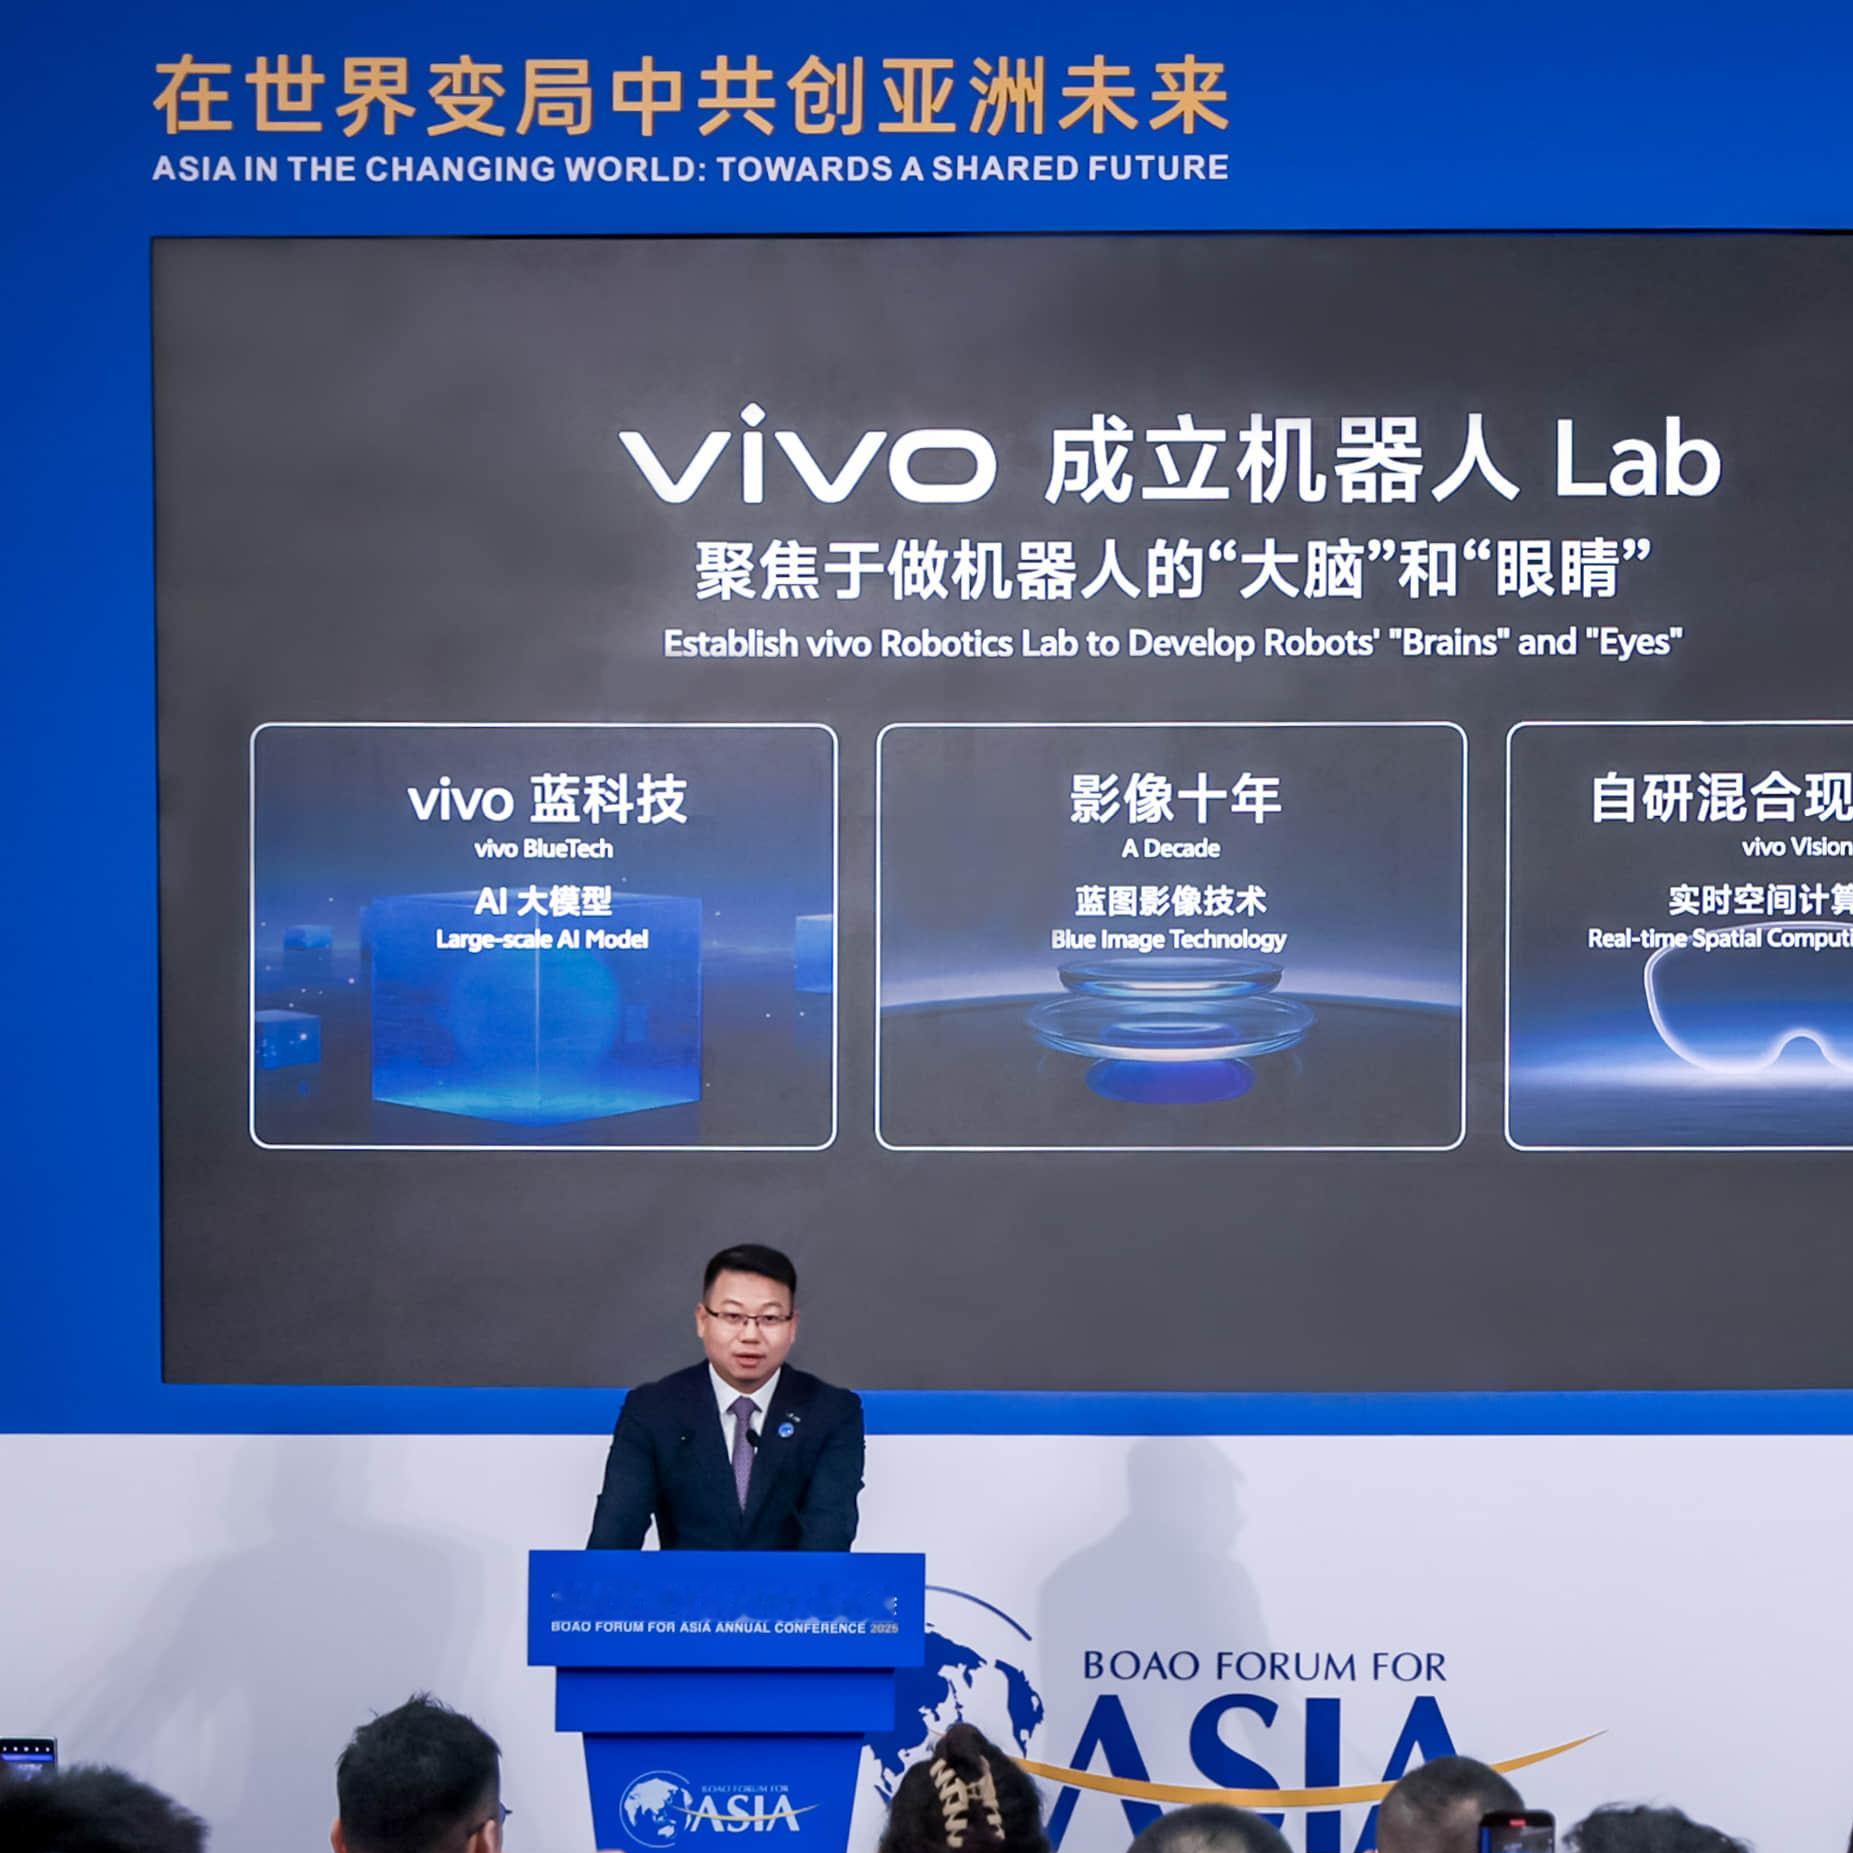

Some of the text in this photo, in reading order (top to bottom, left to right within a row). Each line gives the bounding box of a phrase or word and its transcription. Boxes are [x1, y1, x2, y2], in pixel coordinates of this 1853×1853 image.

[154, 54, 1228, 136] 在世界变局中共创亚洲未来
[153, 155, 1228, 181] ASIA IN THE CHANGING WORLD: TOWARDS A SHARED FUTURE
[619, 403, 1721, 504] vivo 成立机器人 Lab
[664, 627, 1683, 663] Establish vivo Robotics Lab to Develop Robots' "Brains" and "Eyes"
[407, 773, 688, 825] vivo 蓝科技
[1070, 773, 1282, 824] 影像十年
[474, 838, 614, 859] vivo BlueTech
[1121, 838, 1221, 858] A Decade
[1741, 836, 1853, 857] vivo Vision
[474, 885, 613, 917] AI 大模型
[1074, 884, 1267, 917] 蓝图影像技术
[436, 928, 649, 953] Large-scale AI Model
[1052, 929, 1287, 953] Blue Image Technology
[1588, 928, 1688, 949] Real-time
[1693, 928, 1762, 953] Spatial
[551, 1621, 591, 1633] BOAO
[595, 1621, 644, 1633] FORUM
[647, 1621, 676, 1633] FOR
[680, 1621, 711, 1634] ASIA
[715, 1621, 770, 1634] ANNUAL
[774, 1622, 866, 1634] CONFERENCE
[1084, 1651, 1446, 1682] BOAO FORUM FOR
[690, 1794, 800, 1833] ASIA
